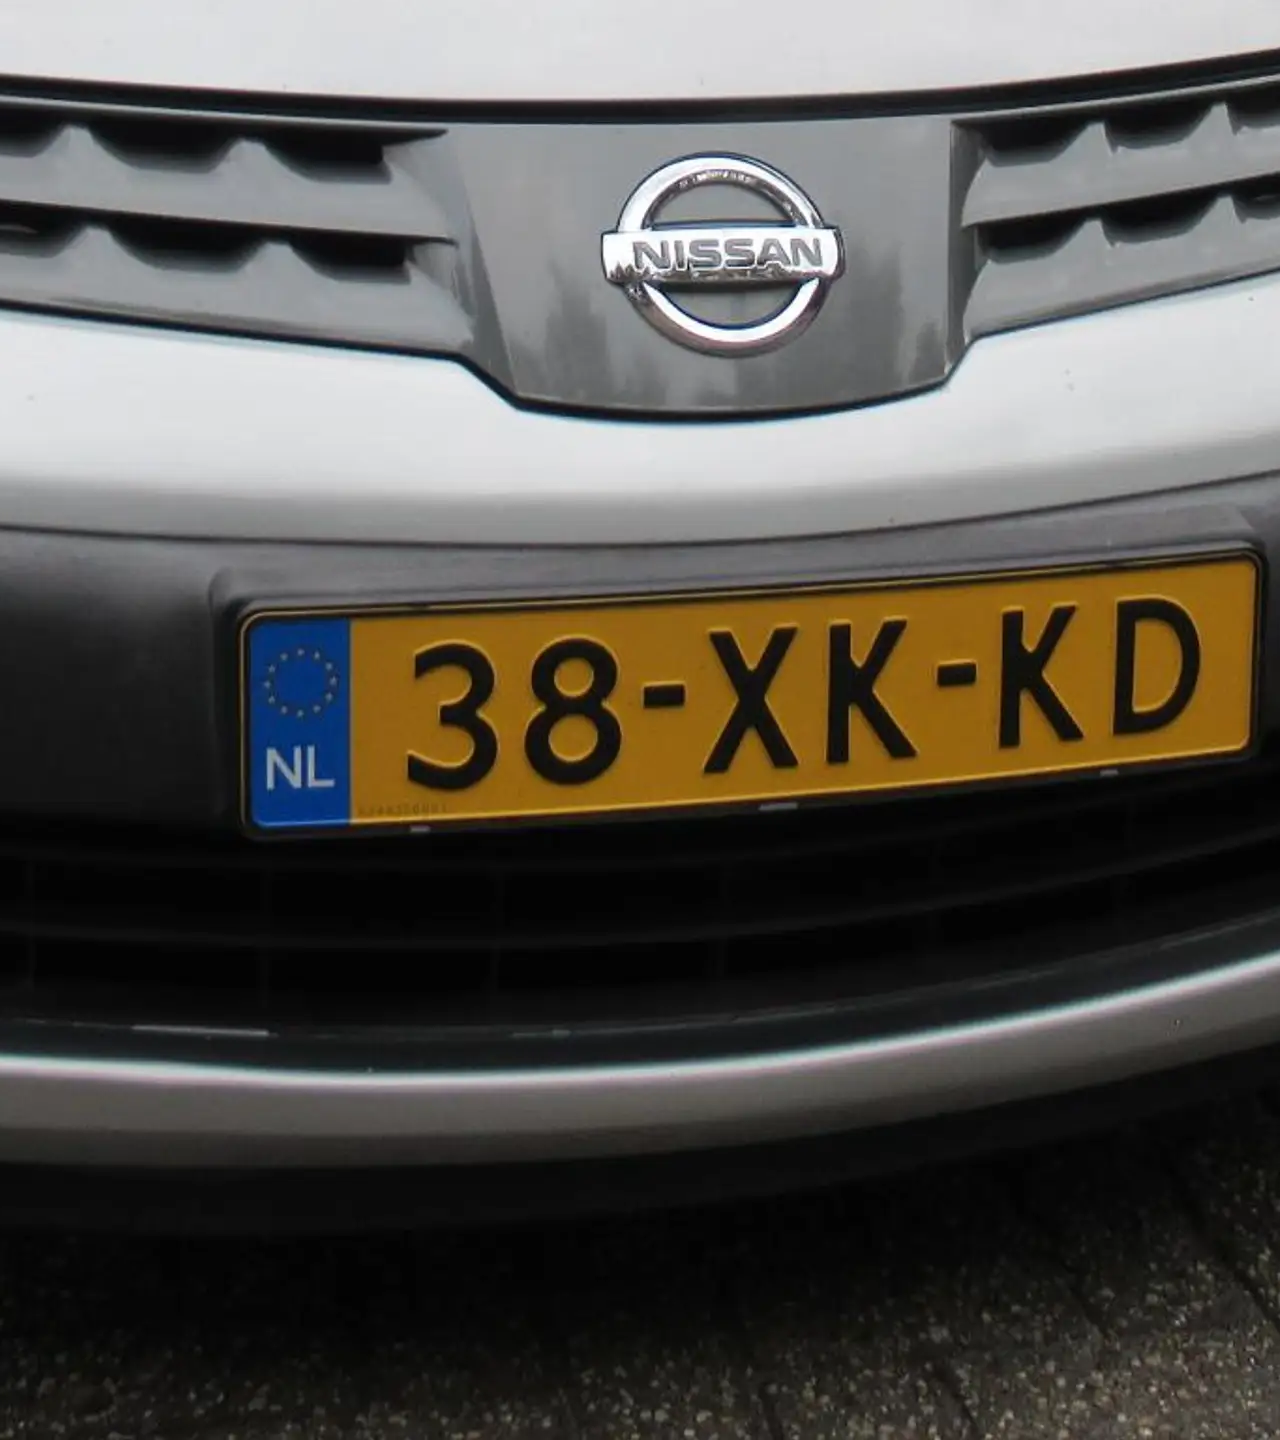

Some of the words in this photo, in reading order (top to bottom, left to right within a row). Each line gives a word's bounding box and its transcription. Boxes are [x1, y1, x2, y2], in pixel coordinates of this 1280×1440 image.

[631, 237, 824, 271] NISSAN
[407, 595, 1202, 792] 38-XK-KD
[266, 744, 336, 791] NL
